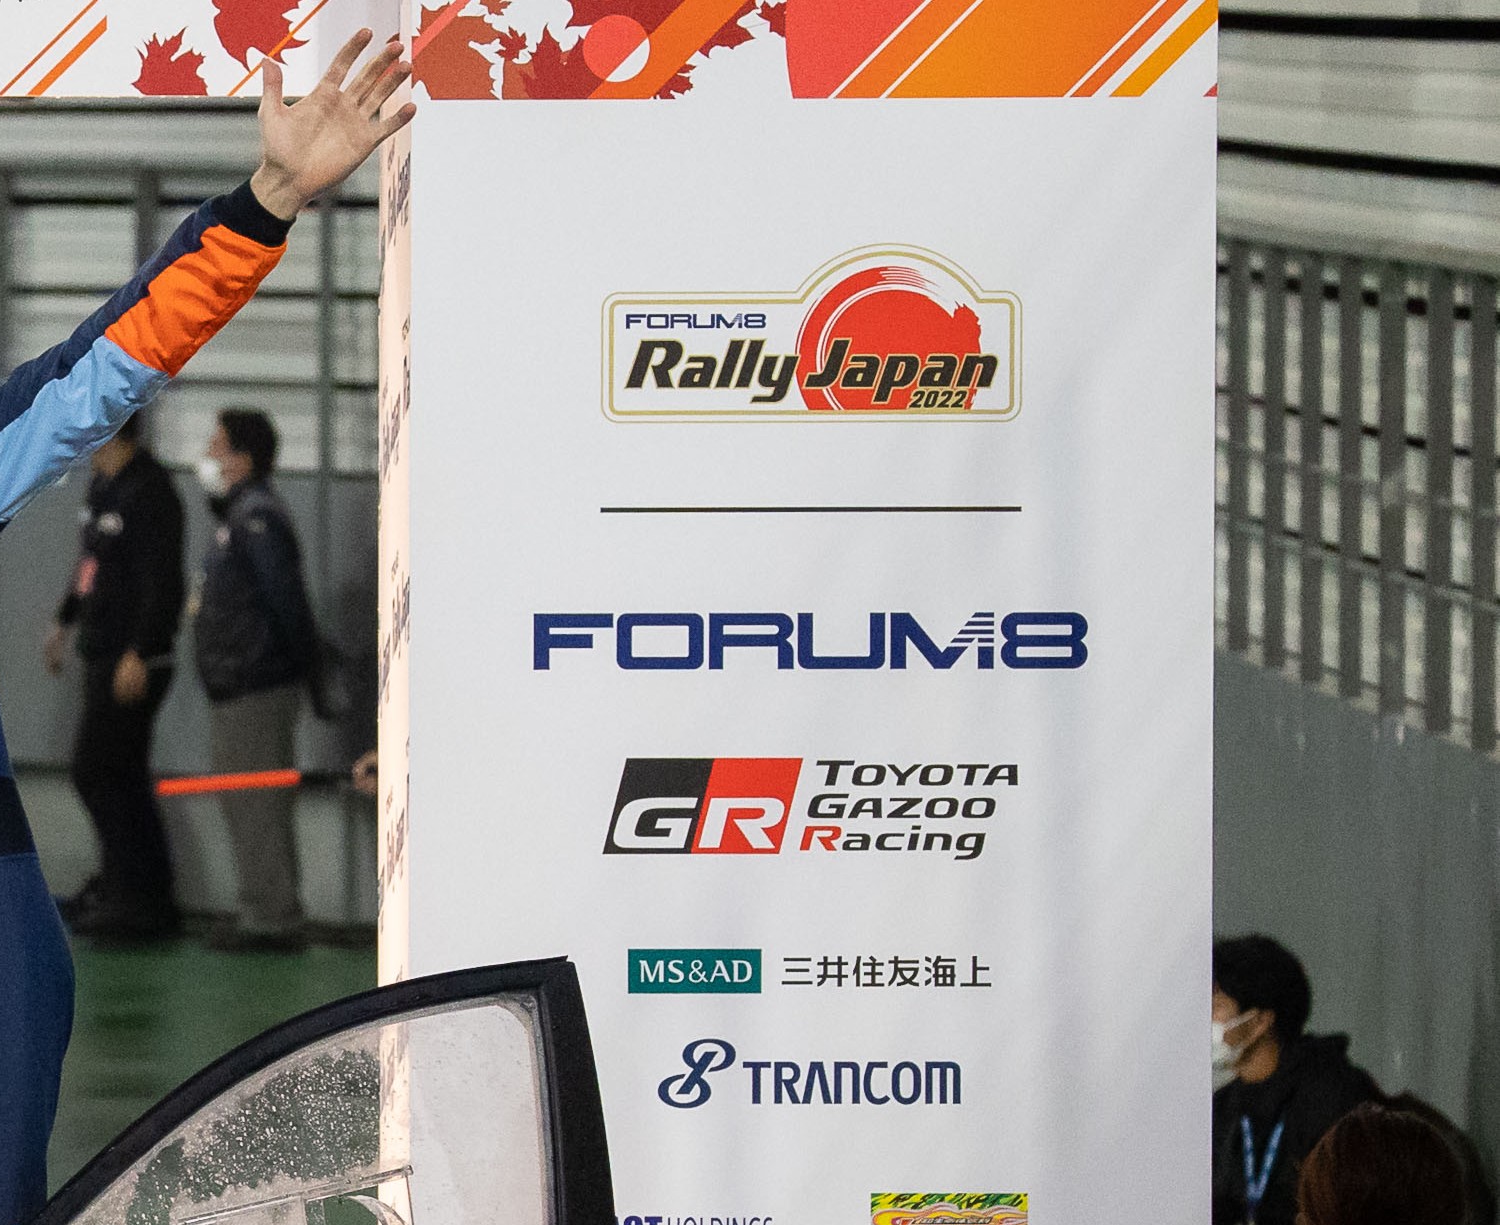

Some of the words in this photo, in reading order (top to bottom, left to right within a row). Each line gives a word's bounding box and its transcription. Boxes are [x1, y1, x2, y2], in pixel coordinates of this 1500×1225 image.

[624, 313, 767, 330] FORUM8
[624, 338, 799, 404] Rally
[802, 338, 999, 392] Japan
[908, 390, 968, 409] 2022
[532, 612, 1088, 671] FORUM8
[816, 760, 1019, 787] TOYOTA
[612, 795, 786, 849] GR
[807, 792, 997, 819] GAZOO
[799, 824, 987, 861] Racing
[638, 958, 754, 983] MS&AD
[780, 955, 994, 989] 三井住友海上
[742, 1059, 963, 1106] TRANCOM
